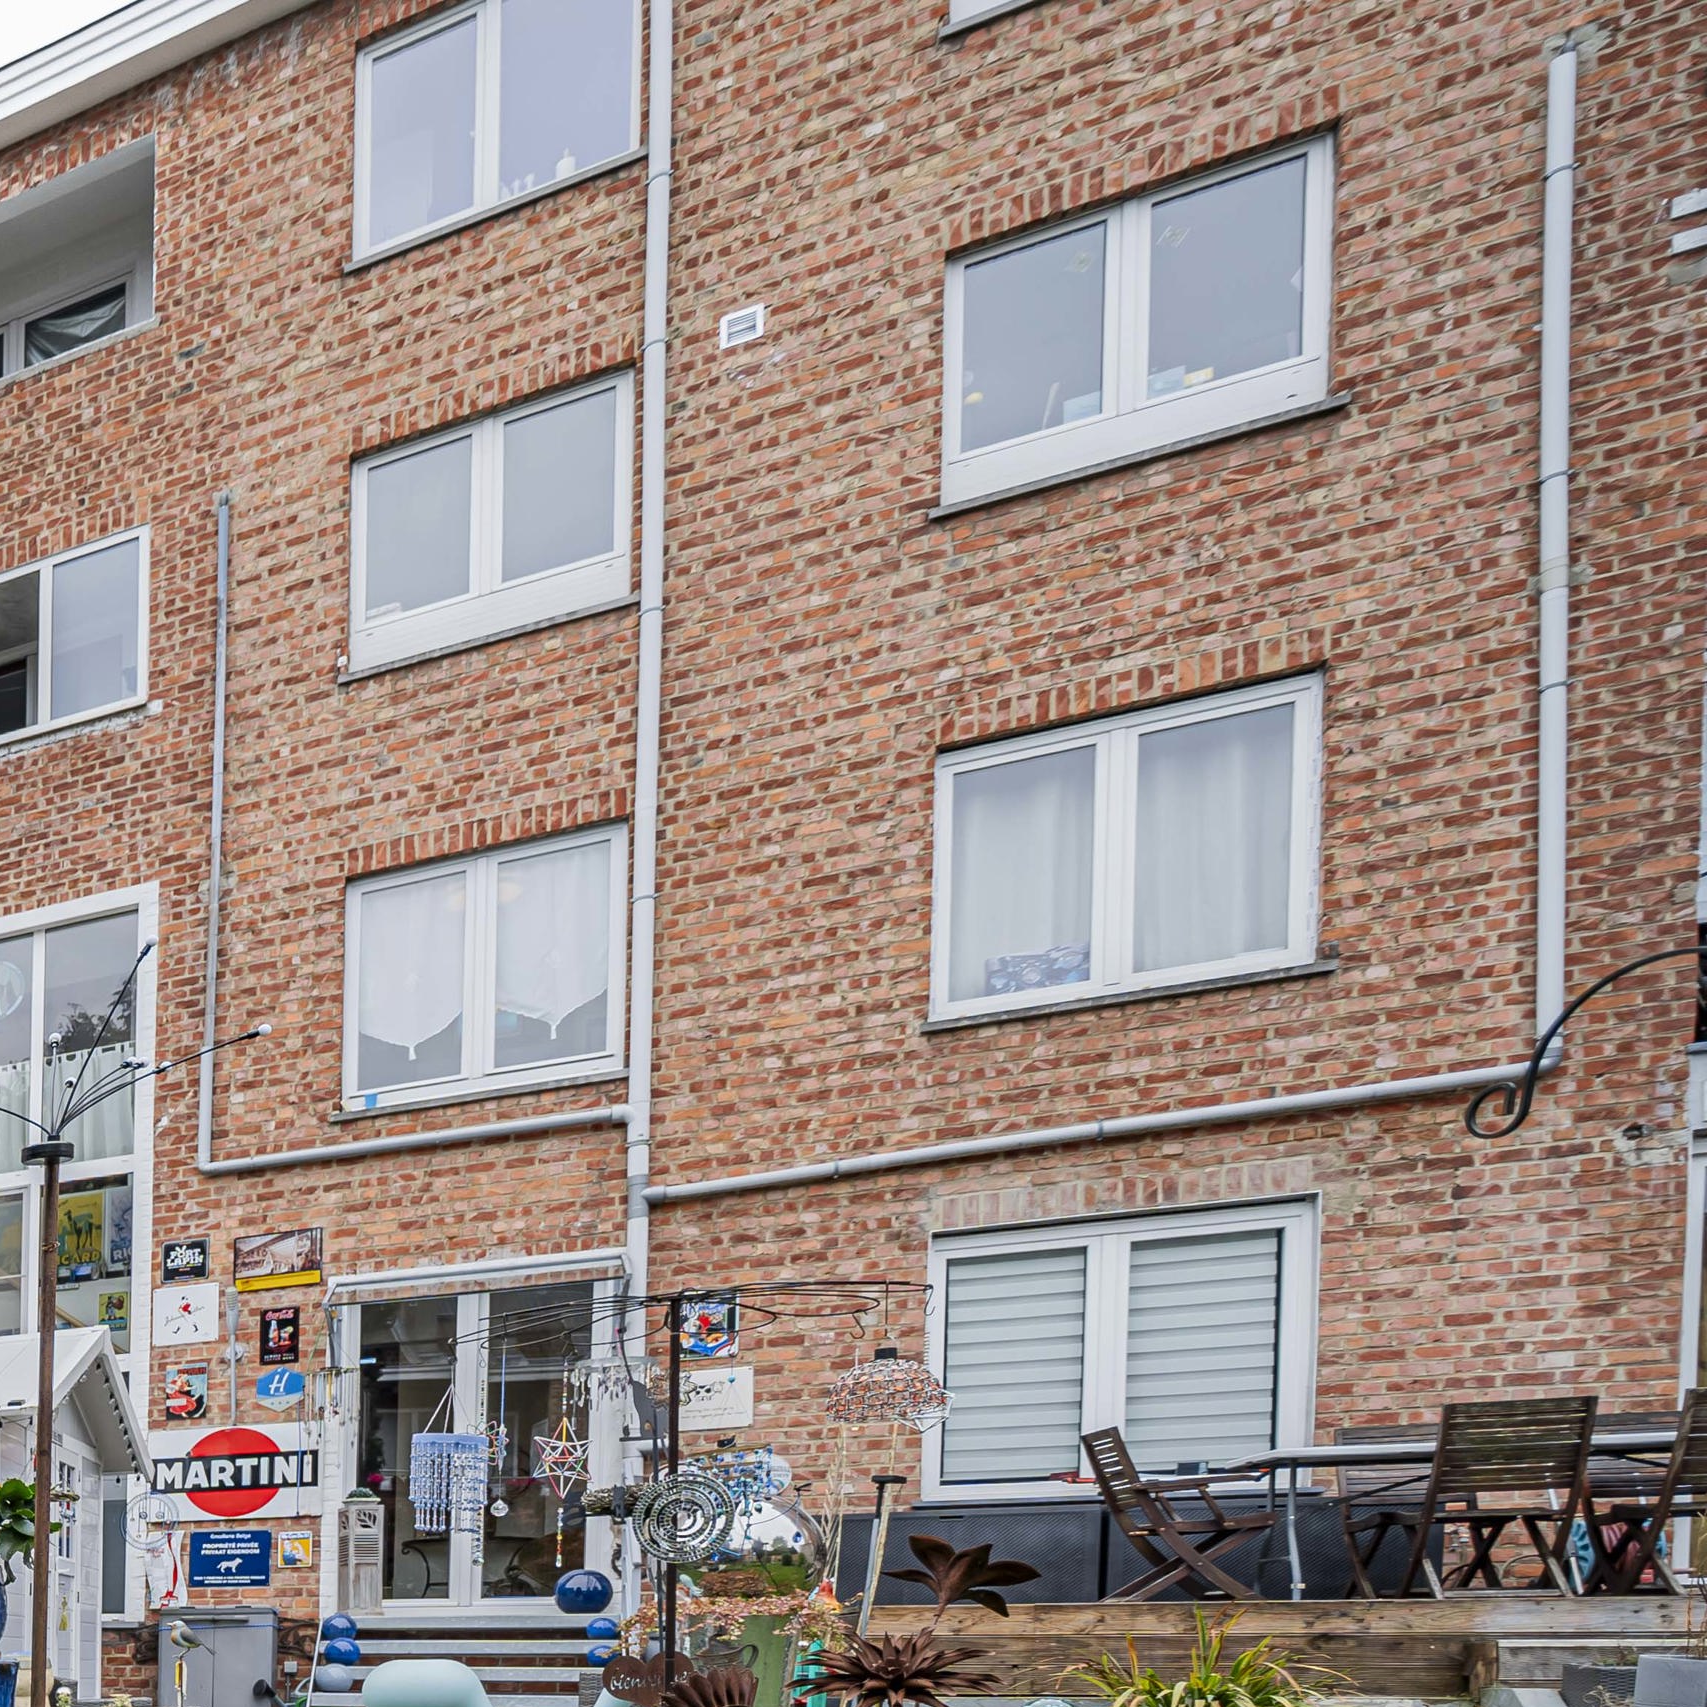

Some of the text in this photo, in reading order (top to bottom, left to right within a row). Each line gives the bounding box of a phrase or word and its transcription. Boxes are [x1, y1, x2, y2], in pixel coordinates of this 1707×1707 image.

[59, 1251, 100, 1265] CARD
[170, 1247, 201, 1259] FORT
[166, 1255, 204, 1267] LAPIN
[156, 1454, 313, 1490] MARTINI
